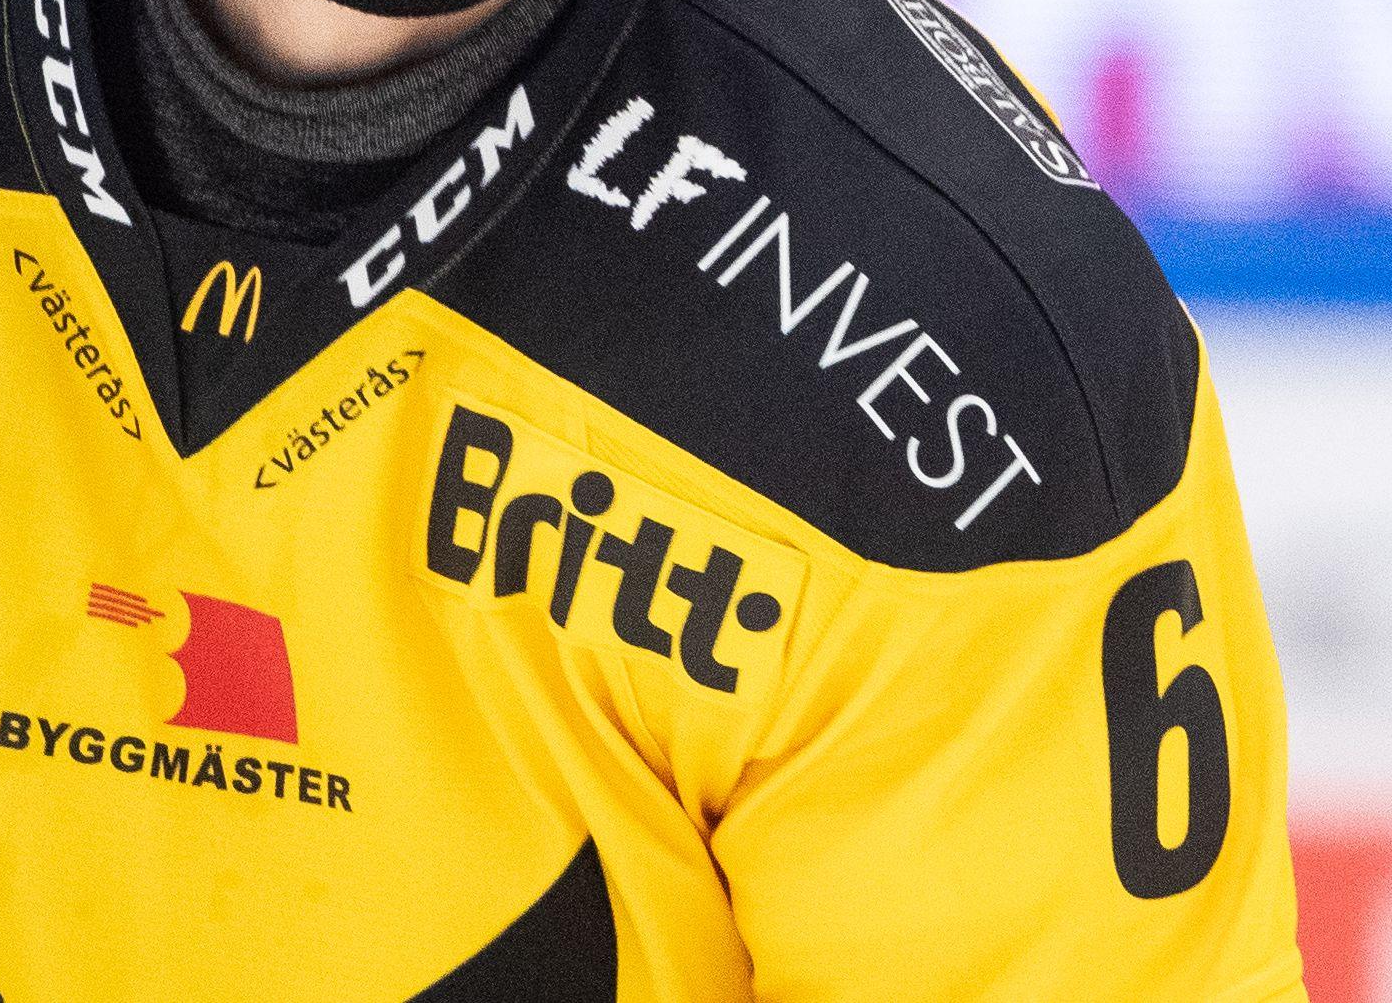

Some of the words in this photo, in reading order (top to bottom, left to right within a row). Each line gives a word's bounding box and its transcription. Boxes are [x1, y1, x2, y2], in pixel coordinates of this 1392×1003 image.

[339, 83, 537, 309] CCM
[566, 95, 748, 232] LF
[696, 194, 1041, 531] INVEST
[1102, 558, 1231, 900] 6
